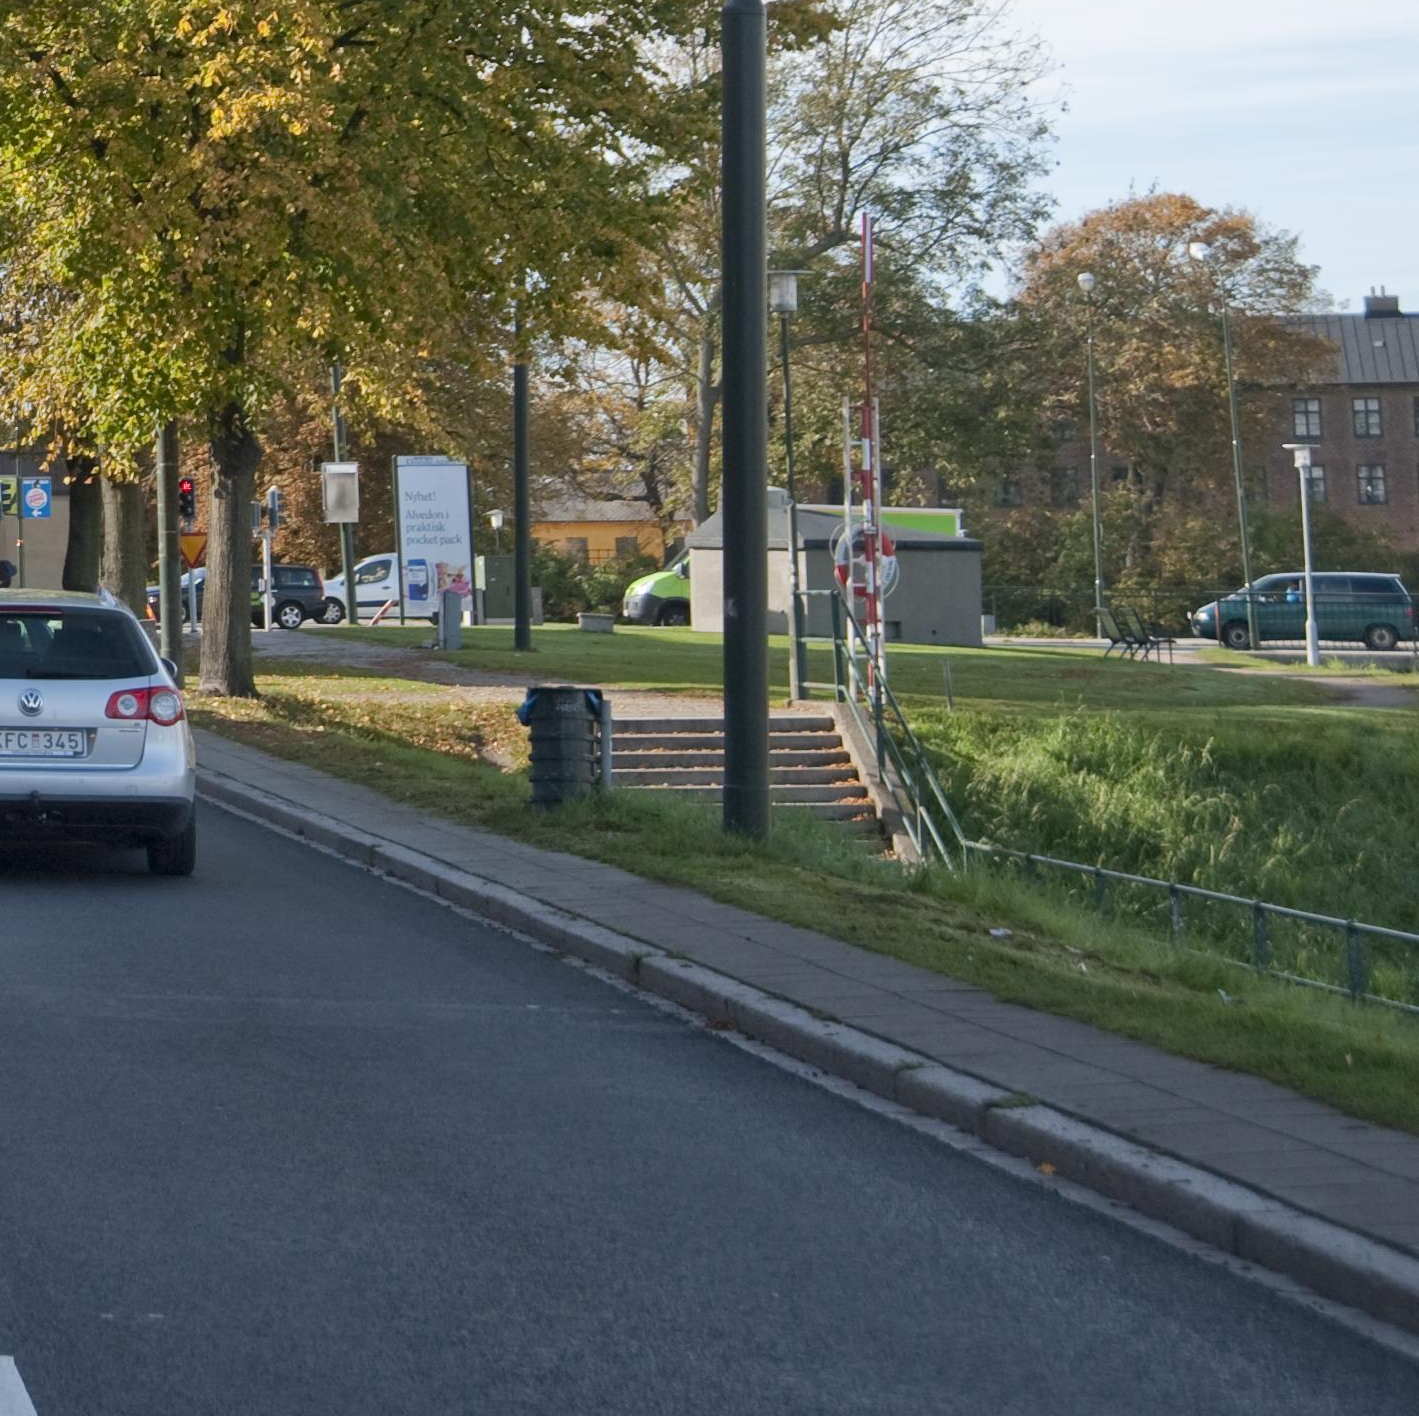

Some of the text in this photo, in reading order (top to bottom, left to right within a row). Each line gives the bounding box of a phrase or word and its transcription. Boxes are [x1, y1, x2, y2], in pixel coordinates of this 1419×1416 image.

[404, 491, 436, 503] Nyhet!
[405, 509, 444, 520] Alvedon
[406, 522, 445, 534] praktisk
[406, 534, 463, 546] pocket pack
[43, 730, 79, 749] 345
